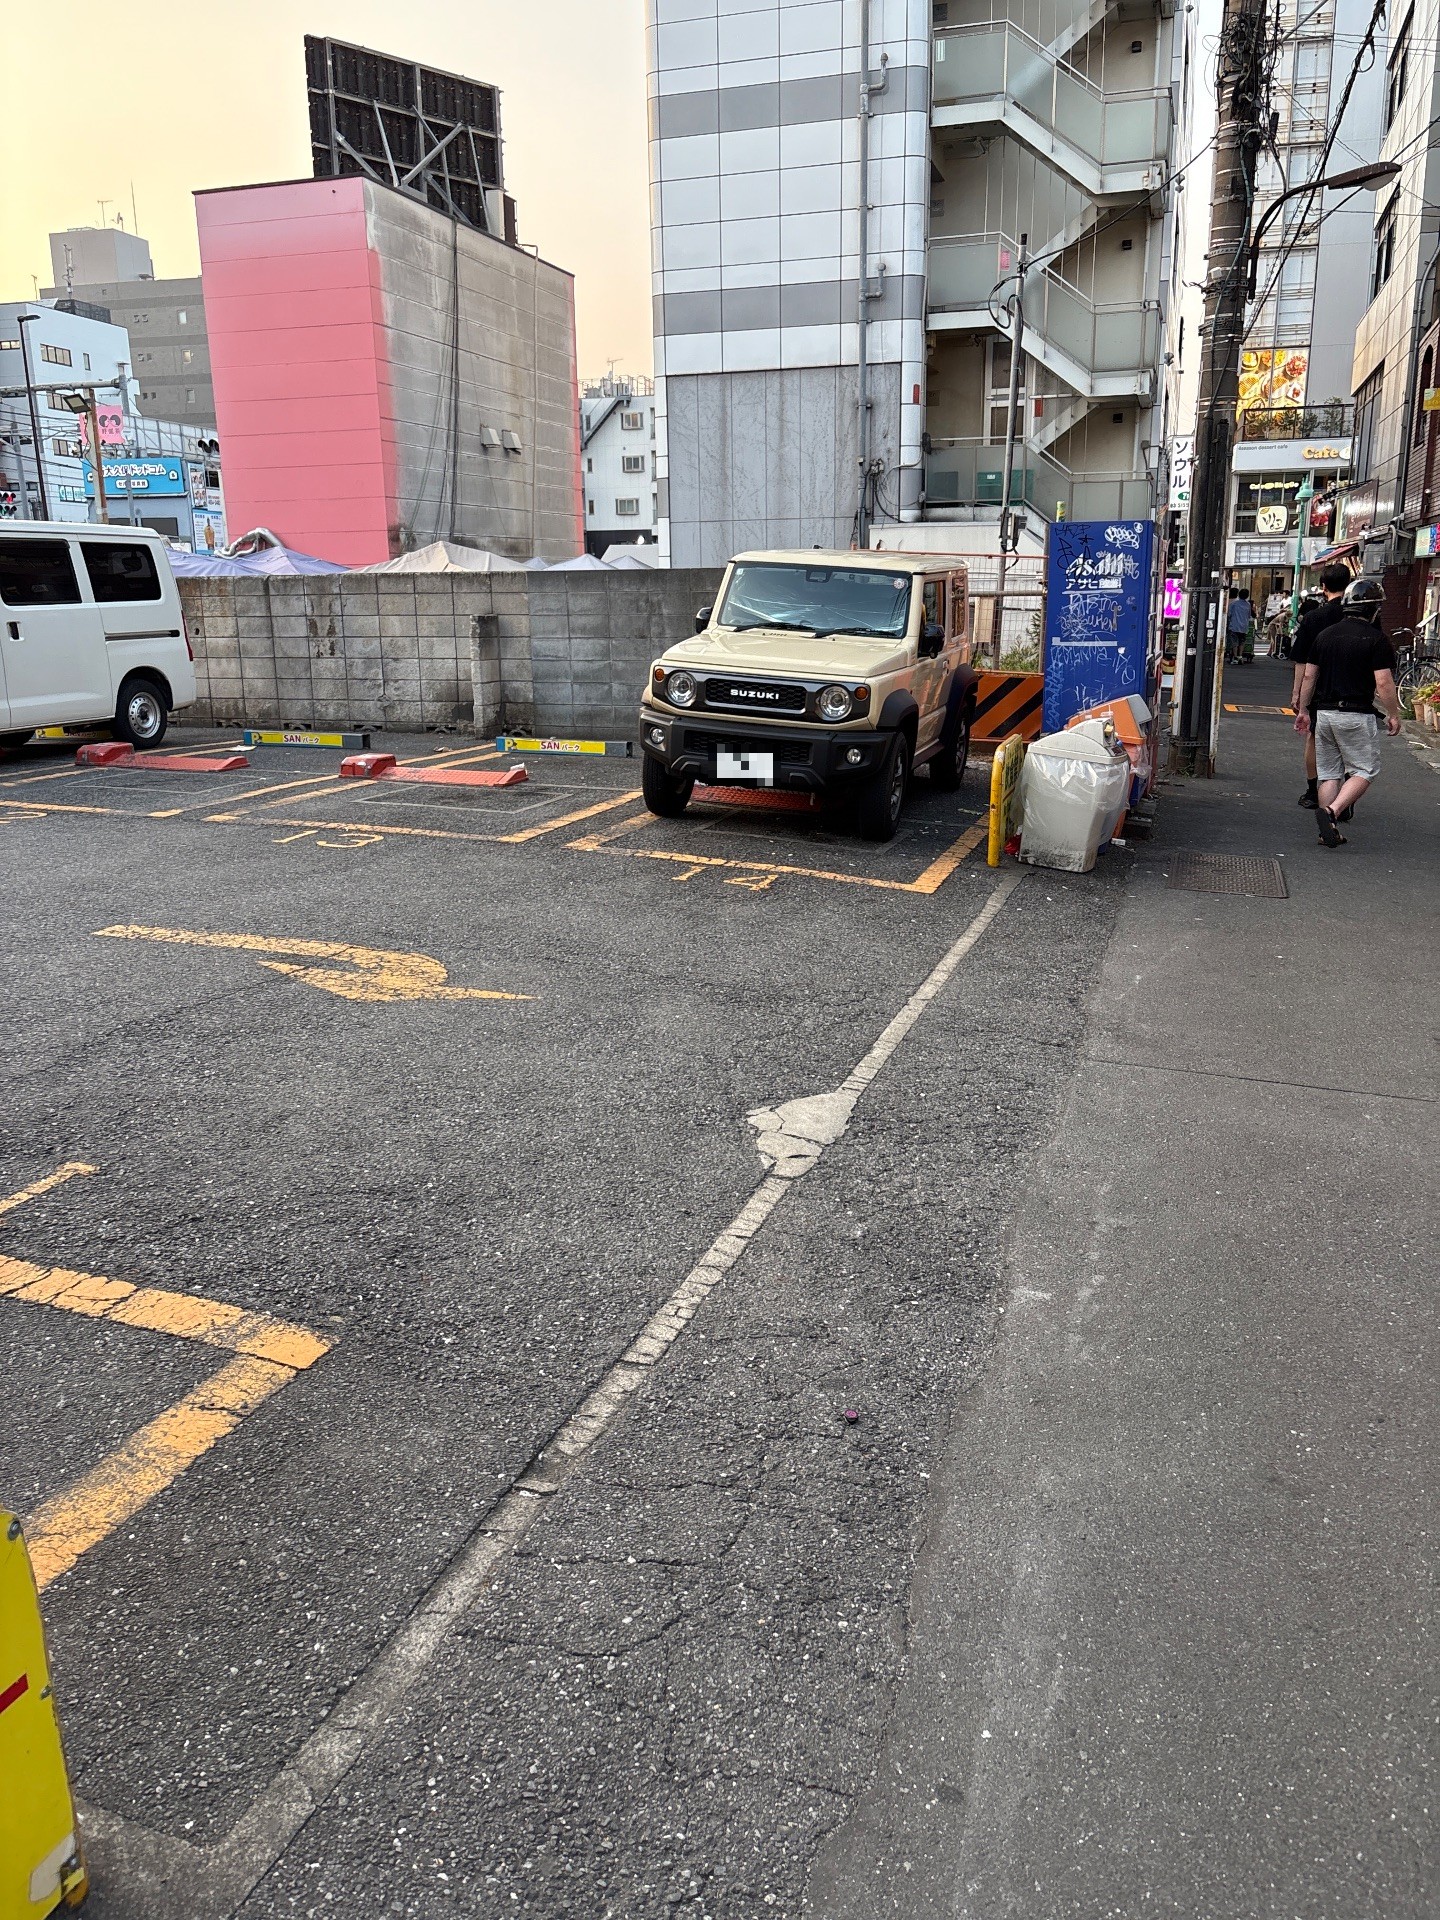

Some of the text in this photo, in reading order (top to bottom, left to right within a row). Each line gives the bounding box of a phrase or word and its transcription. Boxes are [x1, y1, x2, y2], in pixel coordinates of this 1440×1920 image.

[1302, 445, 1339, 459] Cafe
[1172, 441, 1188, 489] ソウル
[730, 689, 779, 699] SUZUKI
[283, 735, 301, 743] SAN
[540, 741, 560, 750] SAN
